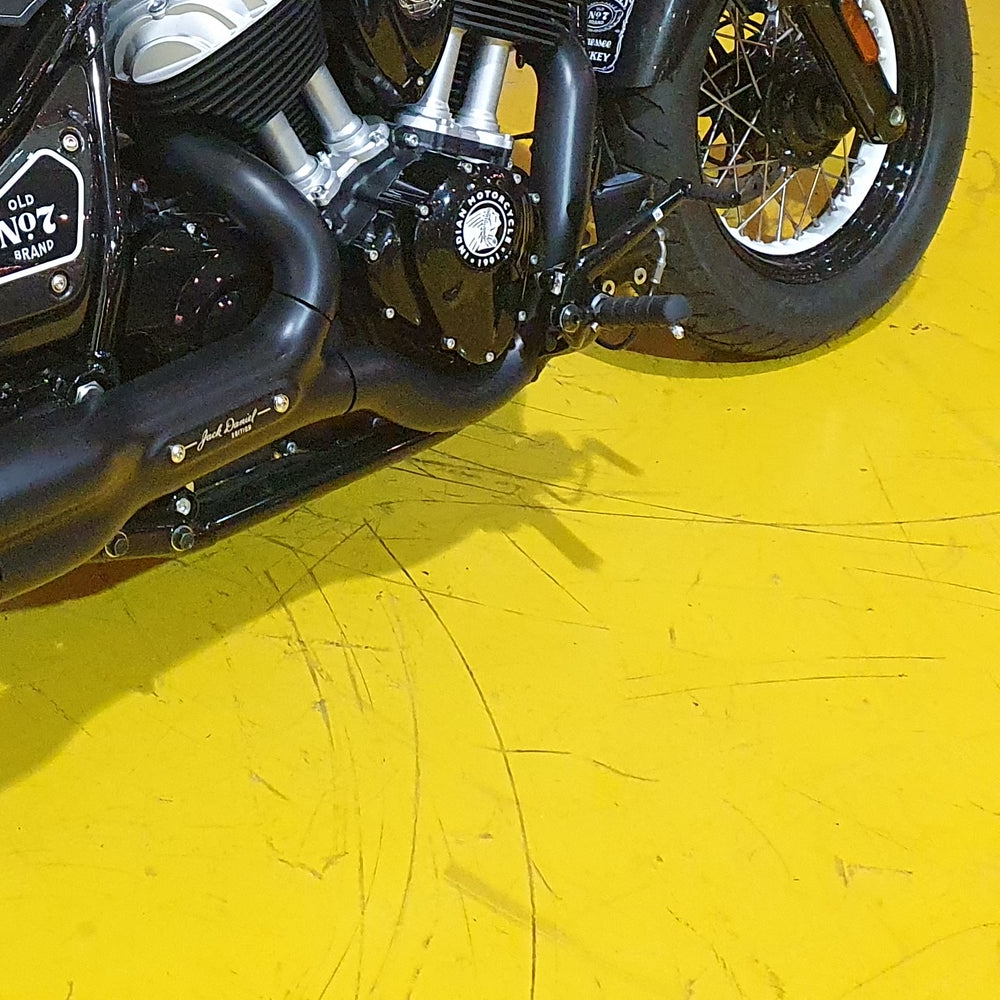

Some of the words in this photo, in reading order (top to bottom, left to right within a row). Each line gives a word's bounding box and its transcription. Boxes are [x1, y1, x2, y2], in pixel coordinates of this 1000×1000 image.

[8, 194, 35, 211] OLD
[455, 208, 470, 259] INDIAN
[467, 190, 515, 244] MOTORCYCLE
[14, 239, 54, 261] BRAND
[197, 423, 223, 452] Jack
[223, 407, 258, 433] Daniel
